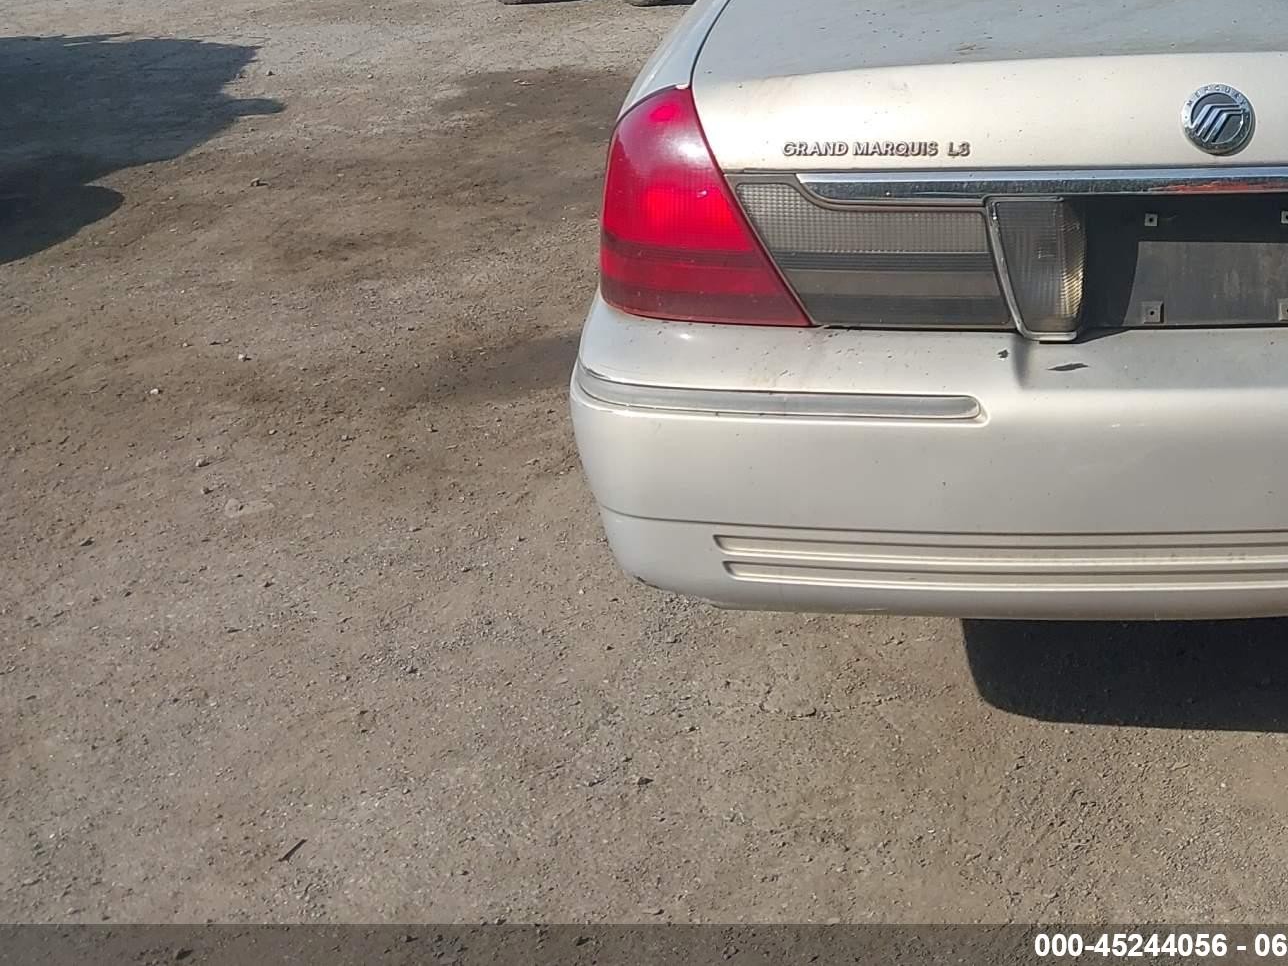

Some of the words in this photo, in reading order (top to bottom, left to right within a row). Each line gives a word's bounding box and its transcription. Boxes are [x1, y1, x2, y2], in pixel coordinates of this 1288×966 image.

[783, 141, 849, 157] GRAND
[852, 141, 939, 157] MARQUIS
[947, 141, 971, 157] LS
